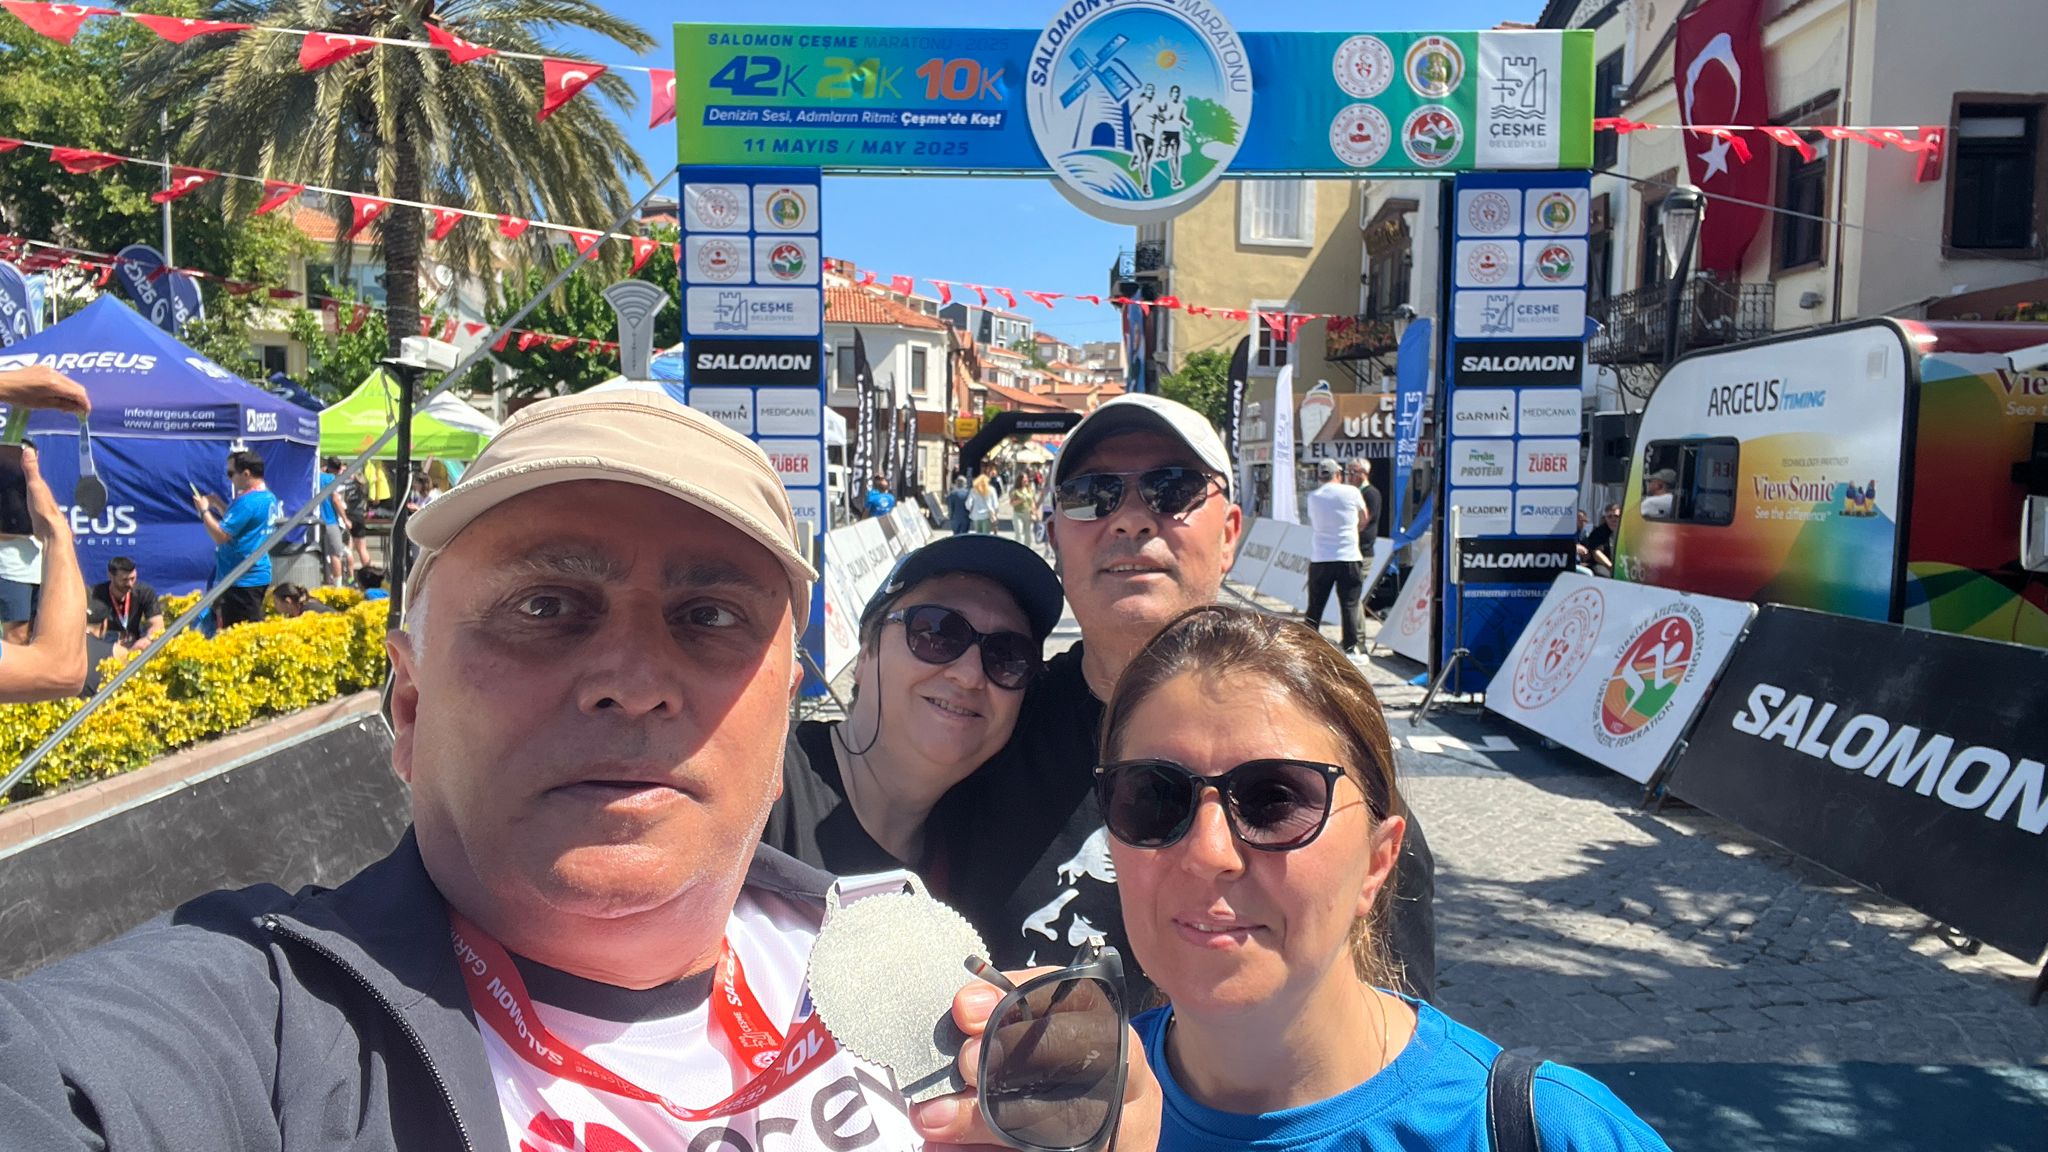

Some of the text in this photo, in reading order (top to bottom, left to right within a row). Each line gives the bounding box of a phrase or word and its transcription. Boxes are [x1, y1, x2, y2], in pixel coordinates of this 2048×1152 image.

[708, 33, 793, 48] SALOMON
[709, 55, 1006, 101] 42K 21K 10K
[709, 108, 1001, 127] Denizin Sesi, Adımların Ritmi: Çeşme'de Koş!
[1489, 123, 1547, 140] ÇEŞME
[744, 139, 769, 153] 11
[772, 139, 839, 154] MAYIS
[862, 140, 906, 155] MAY
[913, 141, 969, 156] 2025
[751, 302, 794, 315] ÇEŞME
[41, 351, 157, 370] ARGEUS
[697, 354, 812, 371] SALOMON
[1461, 355, 1575, 372] SALOMON
[1707, 378, 1826, 417] ARGEUS TIMING
[704, 410, 748, 420] ARMIN
[760, 407, 810, 417] MEDICANA
[1456, 407, 1510, 422] GARMIN
[1522, 407, 1571, 417] MEDICANA
[124, 419, 215, 431] www.argeus.com
[1312, 442, 1329, 458] EL
[1334, 441, 1391, 458] YAPIMI
[1753, 474, 1836, 504] ViewSonic
[1466, 505, 1508, 515] ACADEMY
[1535, 505, 1574, 516] ARGEUS
[1755, 507, 1769, 520] See
[1463, 552, 1568, 569] SALOMON
[1731, 682, 2048, 835] SALOMON
[487, 977, 564, 1067] SALOMON
